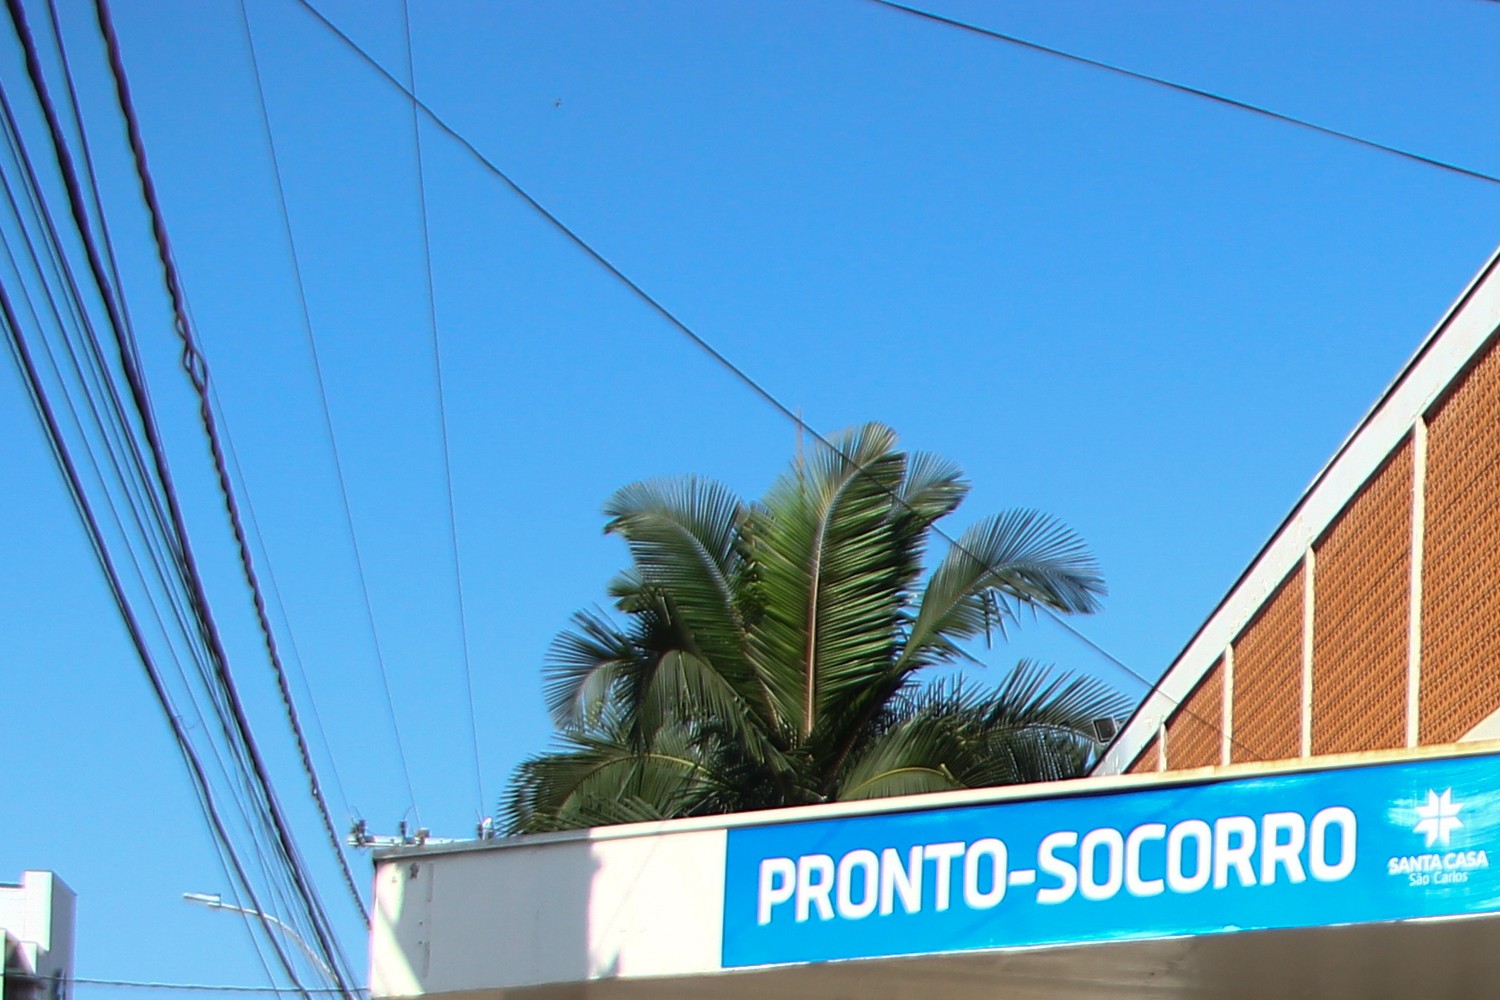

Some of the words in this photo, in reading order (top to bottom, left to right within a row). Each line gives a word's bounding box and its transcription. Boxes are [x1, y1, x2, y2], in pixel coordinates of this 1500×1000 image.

[757, 806, 1357, 926] PRONTO-SOCORRO
[1387, 854, 1443, 876] SANTA
[1444, 850, 1490, 871] CASA
[1409, 872, 1430, 887] São
[1433, 870, 1469, 885] Carlos
